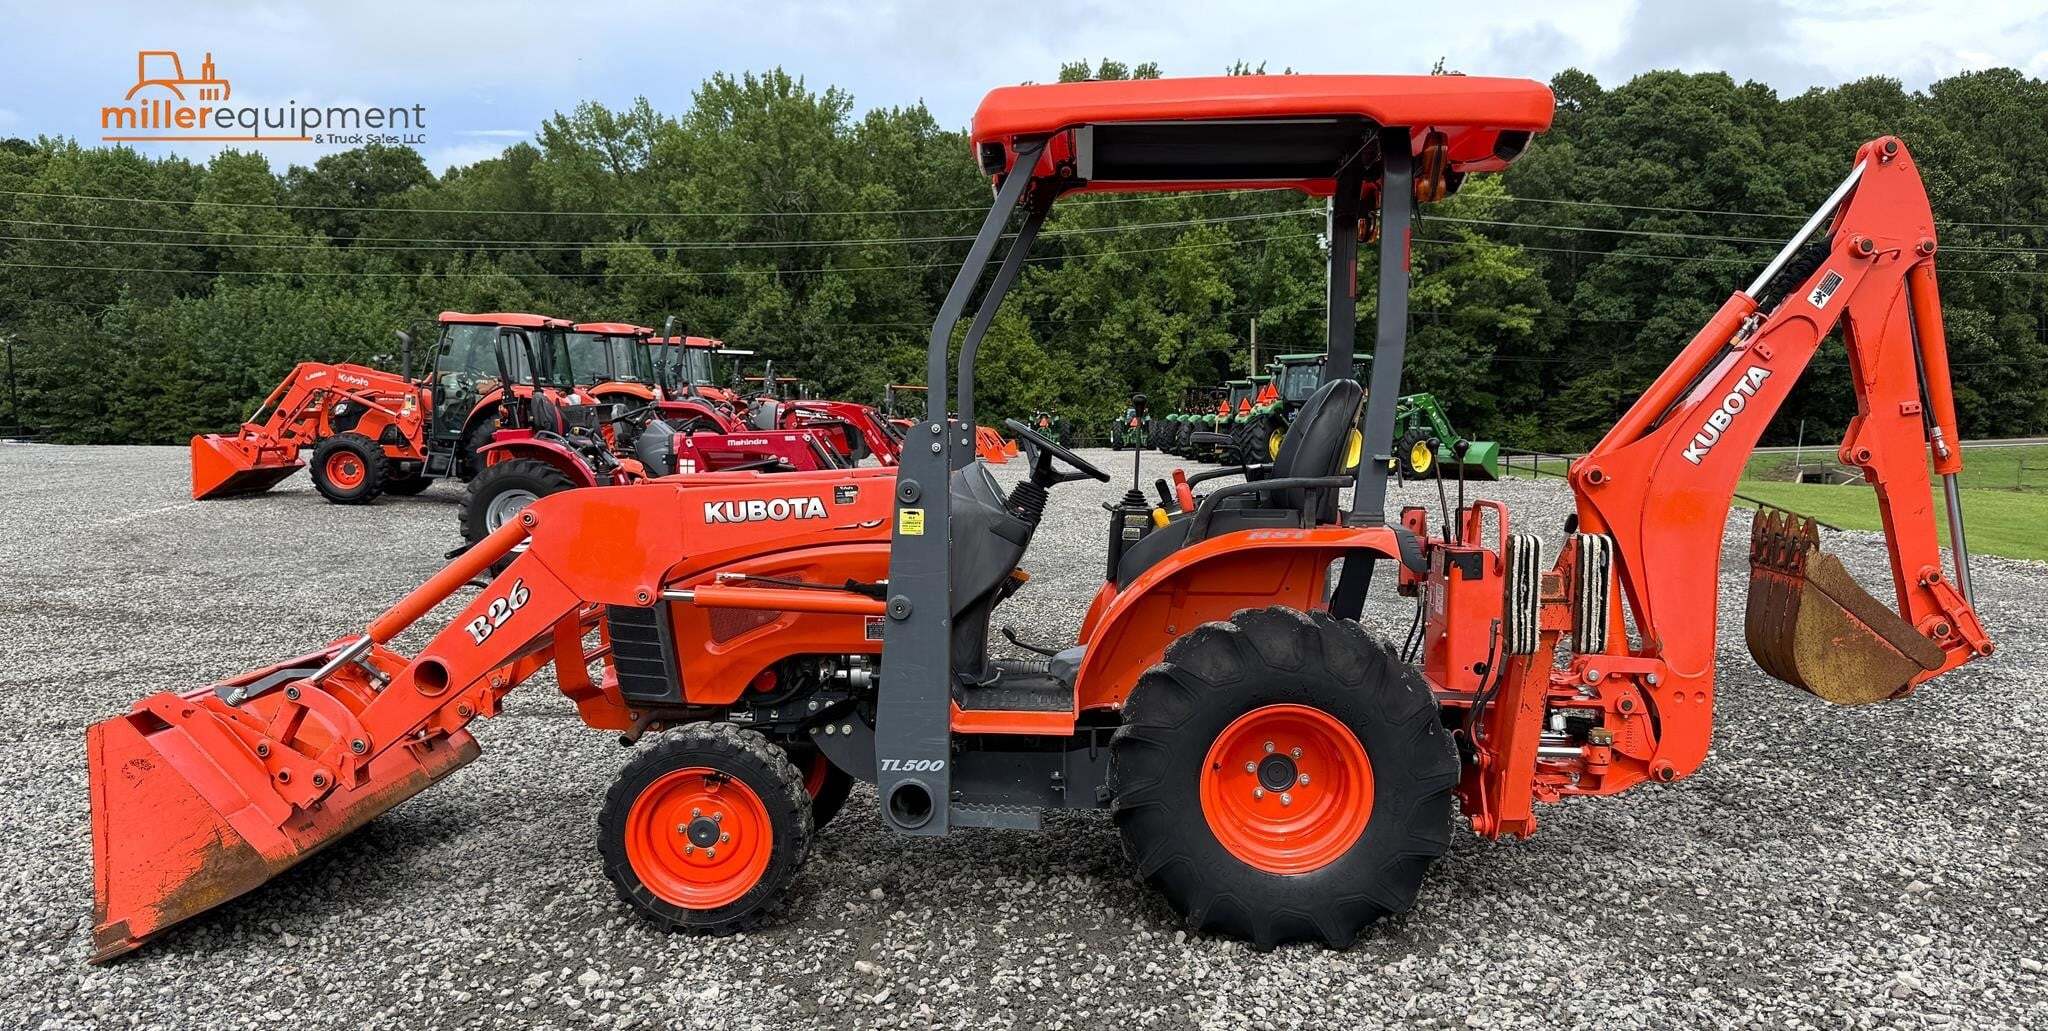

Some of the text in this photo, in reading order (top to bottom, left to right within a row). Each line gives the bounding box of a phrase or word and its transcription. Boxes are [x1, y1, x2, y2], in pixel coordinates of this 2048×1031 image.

[338, 372, 369, 387] Kubota
[1681, 365, 1773, 465] KUBOTA
[727, 438, 769, 447] Mahindra
[704, 497, 827, 524] KUBOTA
[464, 578, 531, 646] B26
[880, 759, 945, 772] TL500
